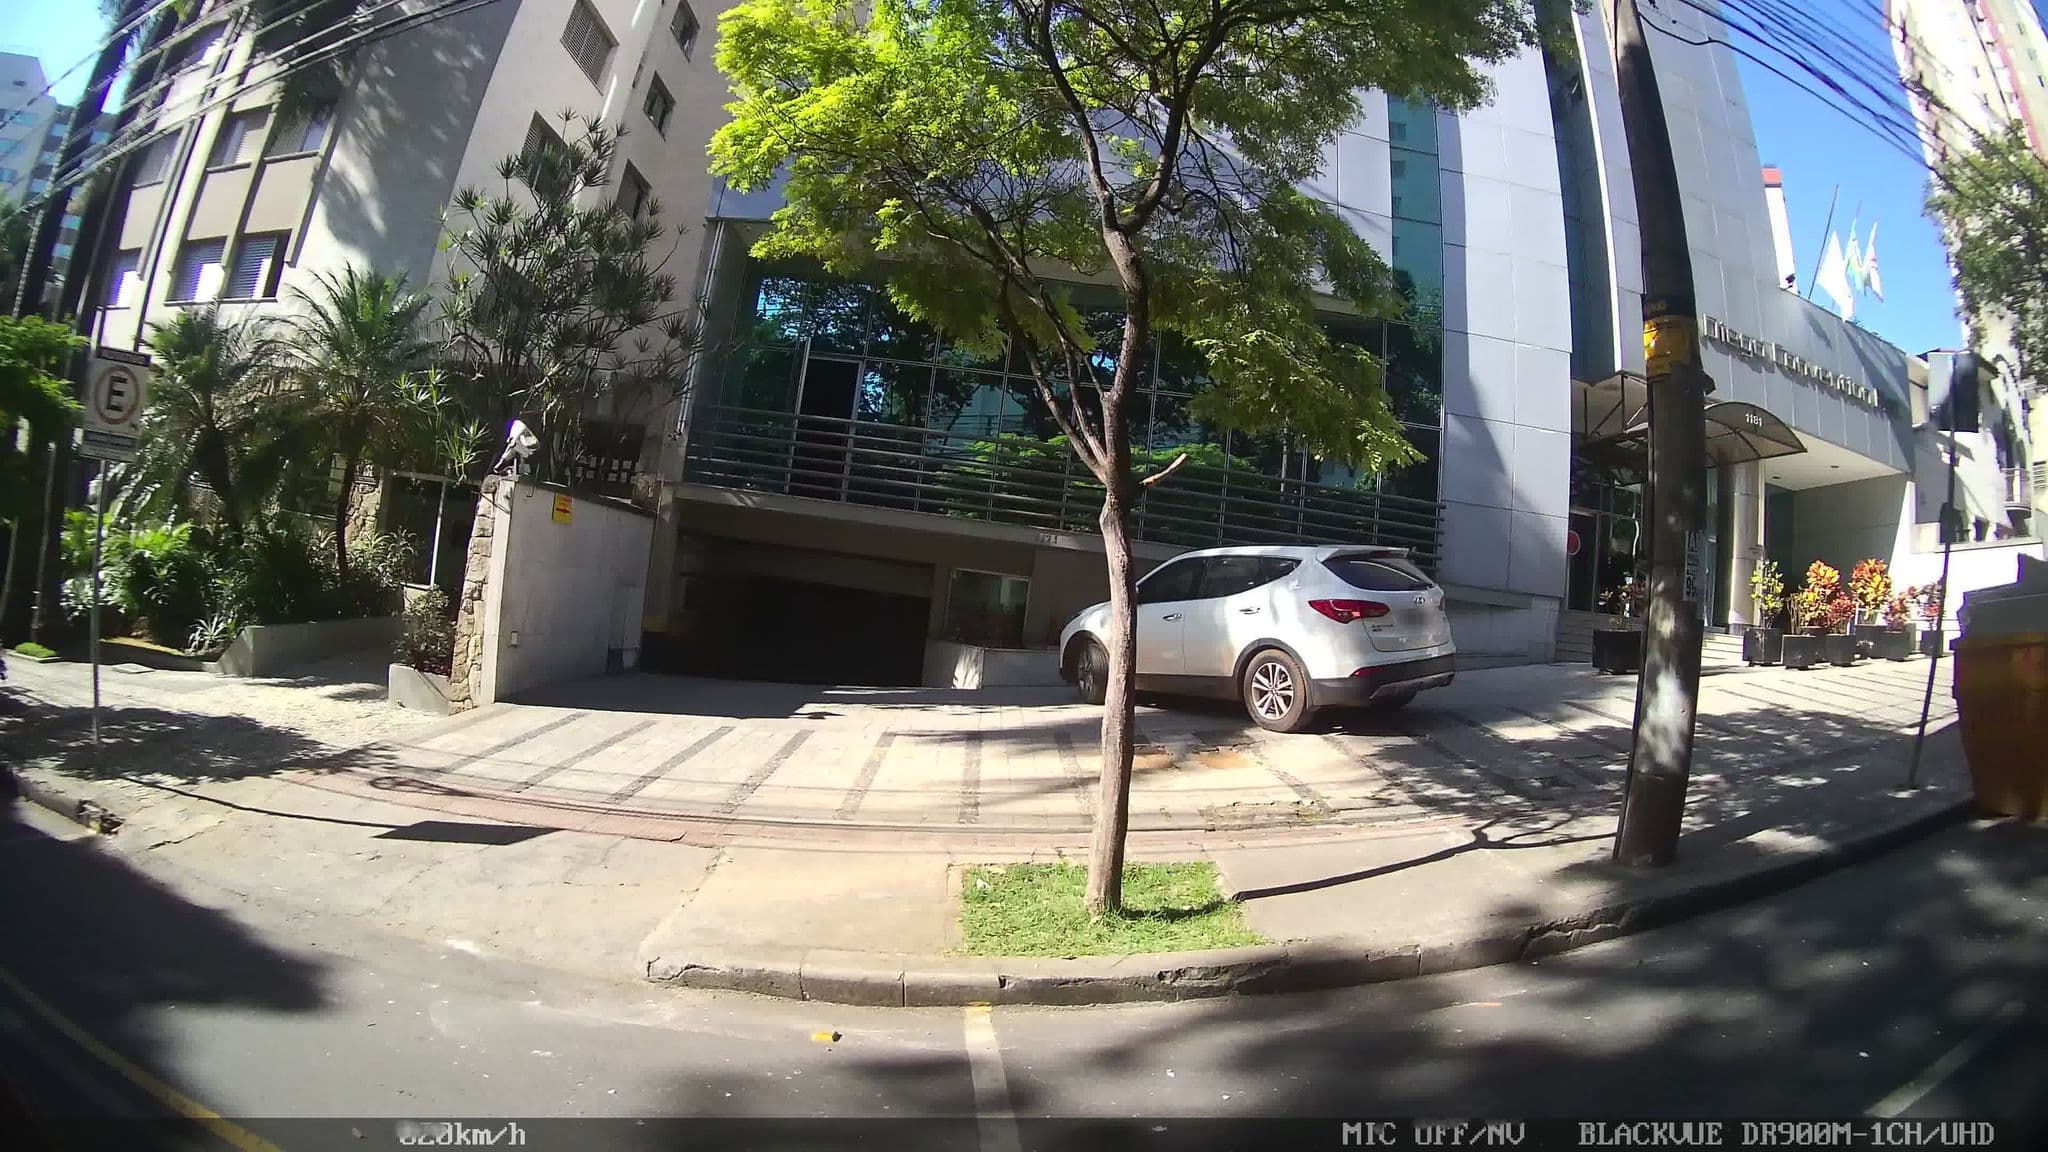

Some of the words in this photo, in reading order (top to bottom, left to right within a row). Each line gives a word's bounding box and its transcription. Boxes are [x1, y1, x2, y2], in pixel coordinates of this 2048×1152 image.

[1702, 313, 1766, 358] Diego
[106, 375, 129, 412] E
[1745, 412, 1763, 427] 1181
